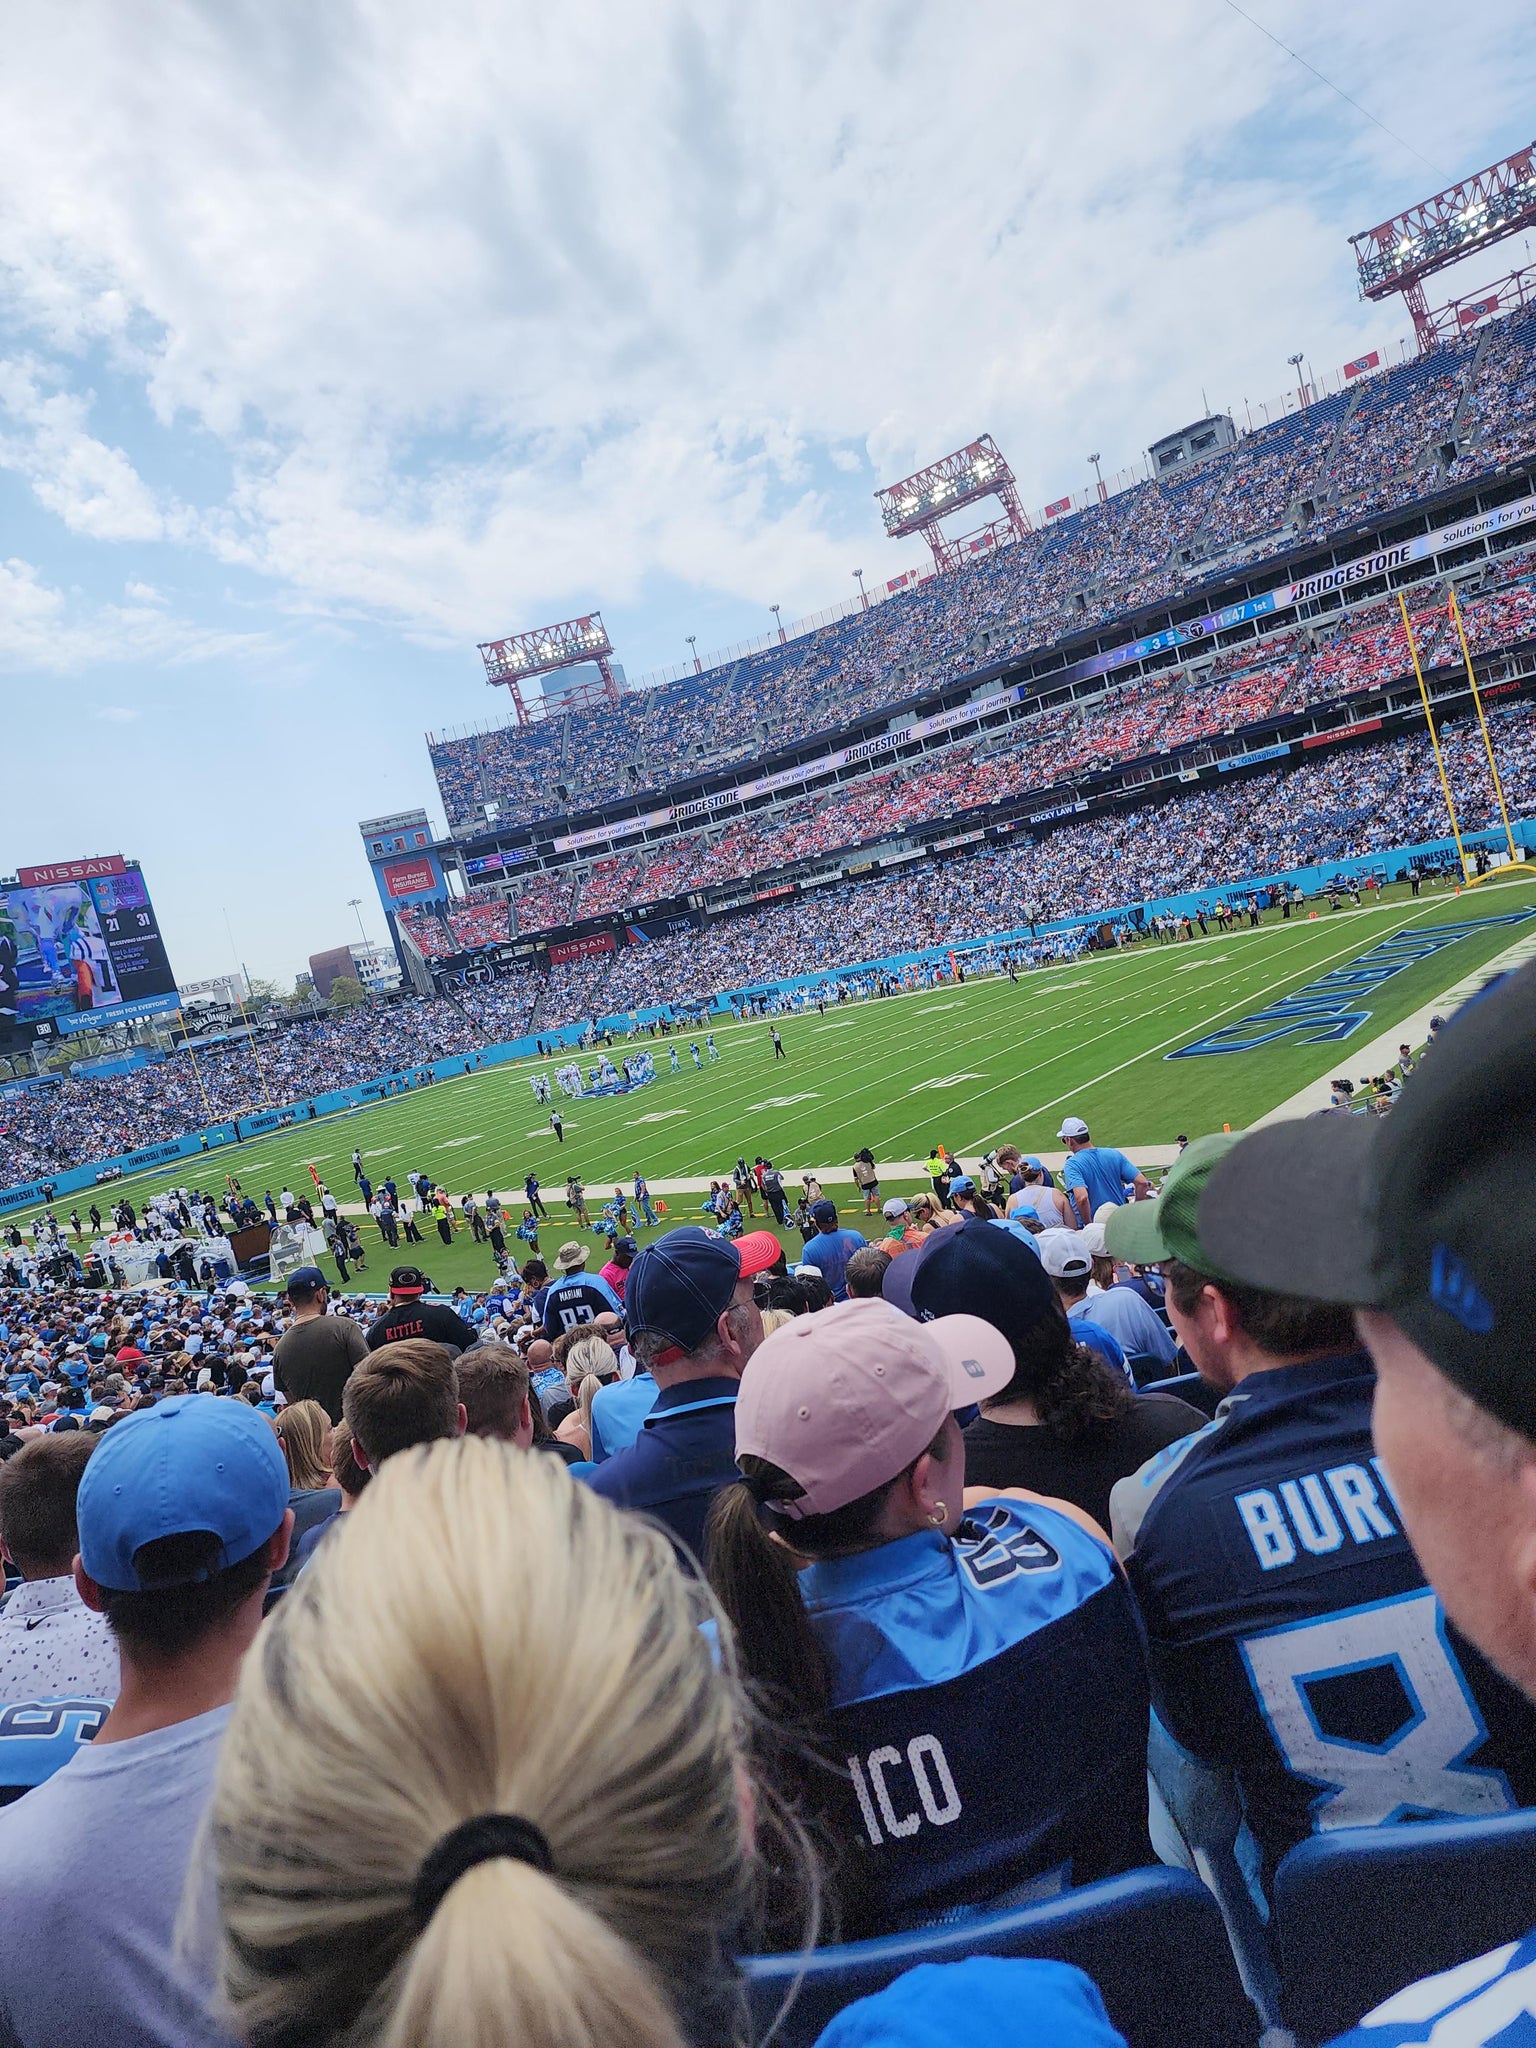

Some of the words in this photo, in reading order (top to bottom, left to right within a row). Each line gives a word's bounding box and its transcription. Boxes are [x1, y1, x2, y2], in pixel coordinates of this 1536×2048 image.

[1442, 520, 1494, 544] Solutions
[1497, 511, 1514, 531] for
[1290, 545, 1411, 602] BRIDGESTONE
[1152, 639, 1162, 650] 3
[1252, 602, 1268, 613] 1st
[1023, 685, 1038, 696] 2n
[1482, 681, 1521, 698] verizon
[928, 711, 958, 730] Solutions
[959, 708, 969, 719] for
[969, 702, 985, 718] your
[985, 694, 1012, 712] journey
[1326, 727, 1357, 740] NISSAN
[842, 728, 912, 764] BRIDGESTONE
[1241, 748, 1280, 766] Gallagher
[754, 774, 781, 792] Solutions
[781, 773, 791, 785] for
[790, 769, 804, 783] your
[803, 763, 826, 779] journey
[667, 790, 739, 820] BRIDGESTONE
[1030, 811, 1055, 824] ROCKY
[1055, 805, 1074, 818] LAW
[566, 831, 597, 847] Solutions
[597, 827, 608, 839] for
[607, 825, 622, 838] your
[622, 819, 647, 834] journey
[996, 823, 1016, 834] FedEx
[1408, 848, 1456, 868] TENNESSEE
[34, 861, 113, 882] NISSAN
[391, 875, 407, 884] Farm
[407, 870, 427, 882] Bureau
[392, 876, 429, 890] INSURANCE
[106, 918, 120, 932] 21
[136, 912, 151, 927] 31
[557, 937, 606, 956] NISSAN
[507, 959, 531, 973] Kroger
[176, 976, 233, 995] NISSAN
[79, 1013, 102, 1026] Kroger
[106, 1008, 124, 1019] FRESH
[125, 1006, 137, 1014] FOR
[199, 1005, 228, 1016] FRONTIER
[192, 1014, 207, 1032] JACK
[251, 1114, 278, 1130] TENNESSEE
[127, 1149, 160, 1167] TENNESSEE
[655, 1201, 663, 1212] 10
[559, 1288, 583, 1302] MARIANI
[385, 1320, 423, 1340] KITTLE
[847, 1734, 962, 1846] ICO
